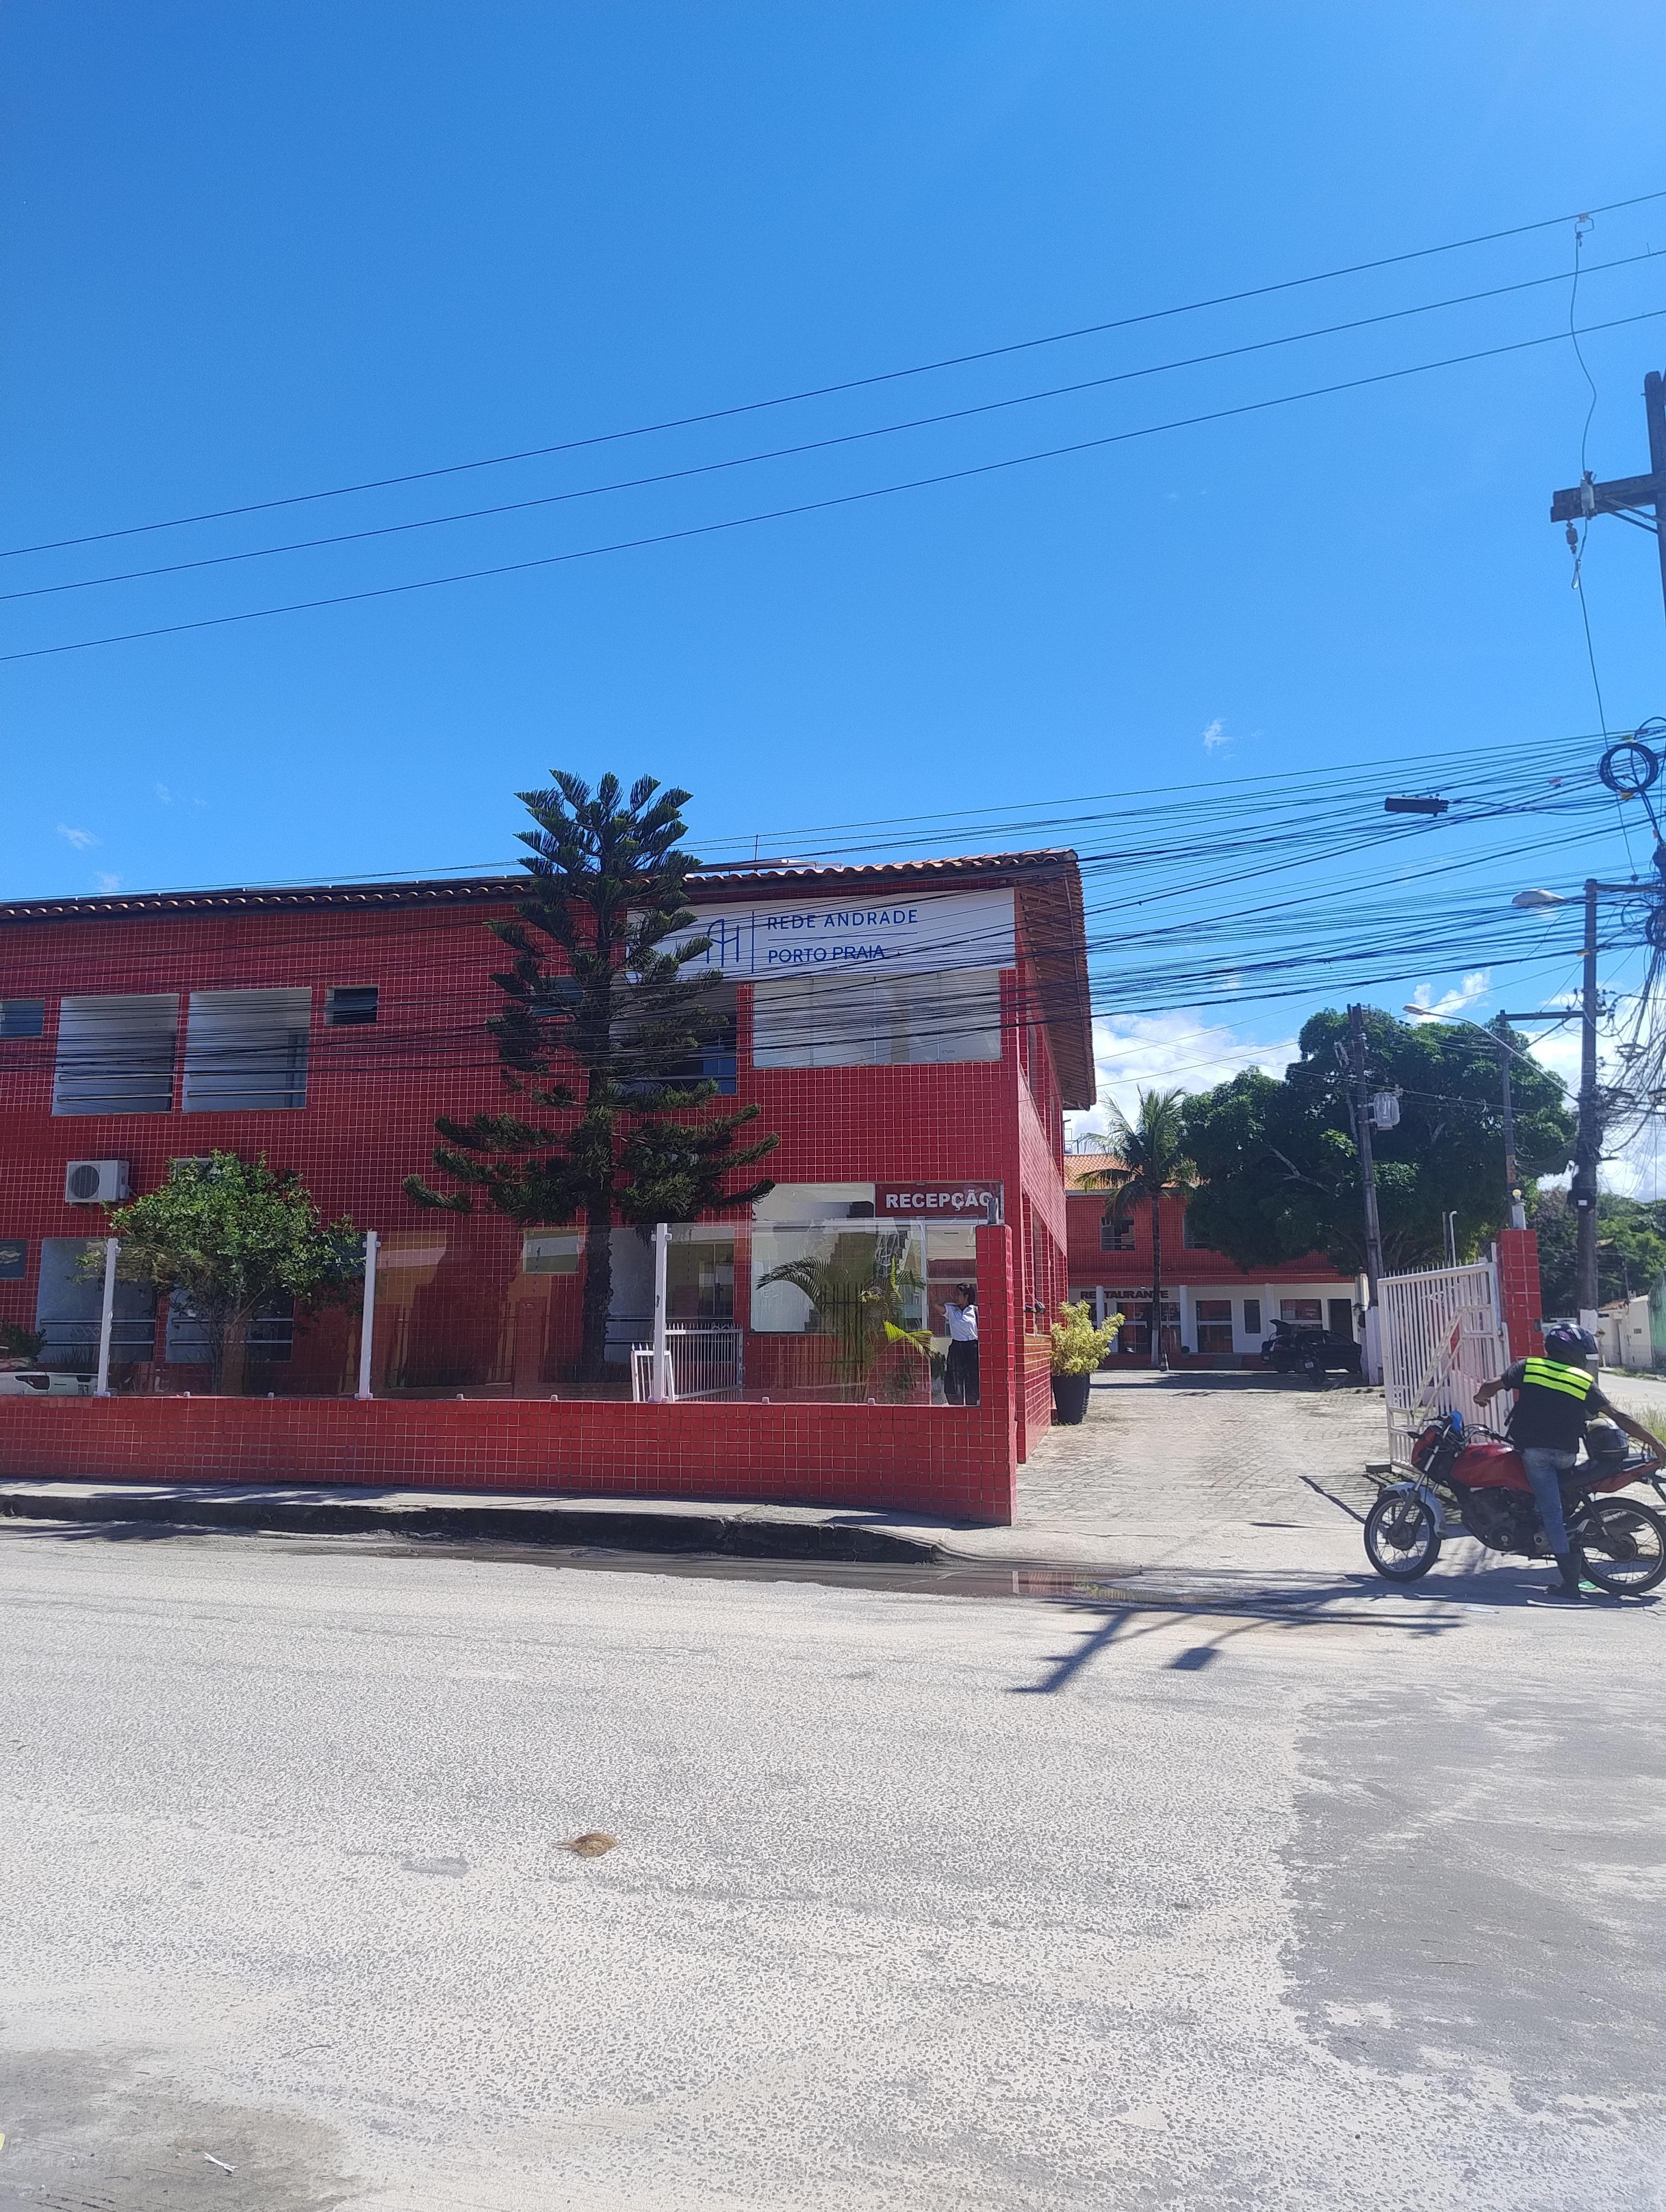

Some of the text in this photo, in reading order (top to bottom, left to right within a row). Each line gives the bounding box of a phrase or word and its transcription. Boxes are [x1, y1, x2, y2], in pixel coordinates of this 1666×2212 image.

[768, 909, 918, 930] REDE ANDRADE
[768, 945, 885, 963] PORTO PRAIA
[886, 1189, 993, 1211] RECEPÇÃO
[1080, 1290, 1169, 1299] RETAURANE
